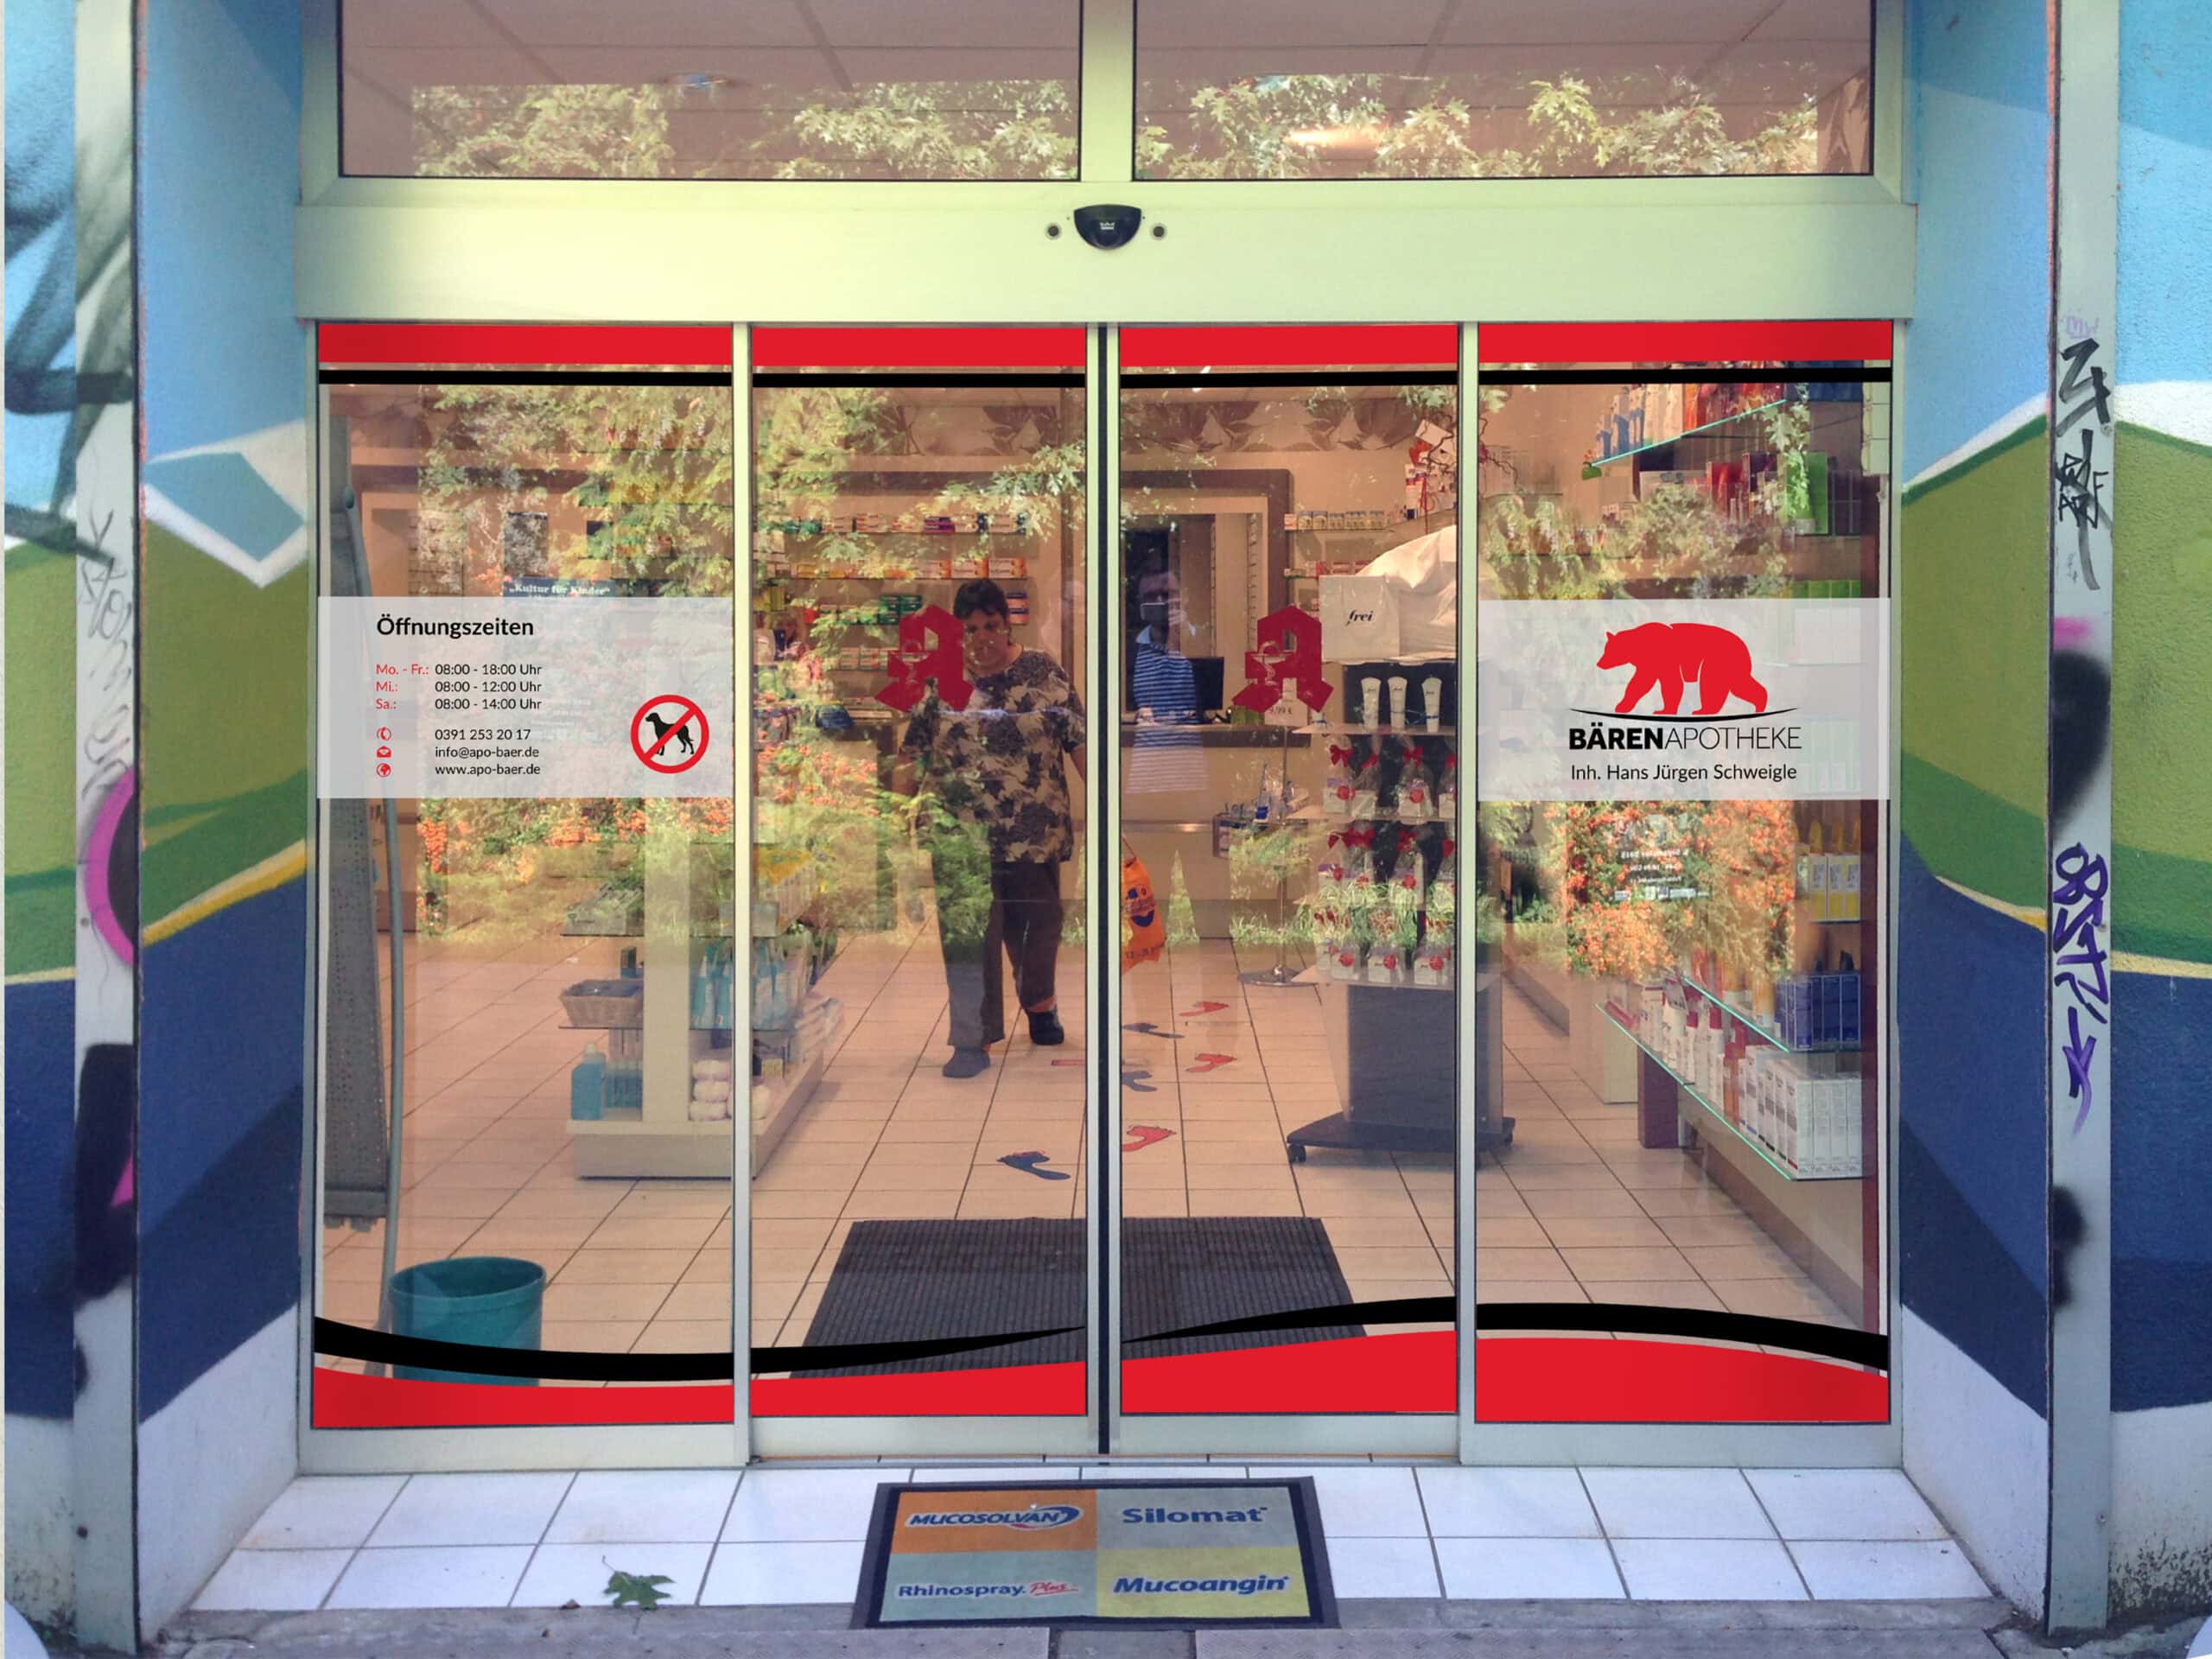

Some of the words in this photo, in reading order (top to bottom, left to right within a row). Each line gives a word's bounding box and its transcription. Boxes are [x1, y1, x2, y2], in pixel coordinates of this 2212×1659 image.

[551, 584, 568, 594] für
[1345, 608, 1375, 627] frei
[376, 613, 535, 639] Öffnungszeiten
[376, 663, 399, 676] Mo.
[411, 663, 429, 676] Fr.:
[435, 663, 471, 676] 08:00
[482, 663, 517, 676] 18:00
[519, 663, 543, 676] Uhr
[376, 681, 398, 693] Mi.:
[435, 680, 471, 693] 08:00
[482, 680, 517, 693] 12:00
[519, 680, 543, 693] Uhr
[376, 698, 397, 710] Sa.:
[435, 697, 471, 710] 08:00
[482, 697, 517, 710] 14:00
[519, 697, 543, 710] Uhr
[435, 728, 467, 741] 0391
[469, 728, 493, 741] 253
[496, 728, 513, 741] 20
[516, 728, 531, 741] 17
[1568, 721, 1802, 750] BÄRENAPOTHEKE
[435, 746, 540, 760] info@apo-baer.de
[435, 763, 541, 777] www.apo-baer.de
[1571, 764, 1602, 781] Inh.
[1606, 764, 1649, 780] Hans
[1652, 763, 1708, 783] Jürgen
[1713, 764, 1797, 783] Schweigle
[909, 1510, 1059, 1526] MUCOSOLVAN
[1029, 1580, 1071, 1597] Plus
